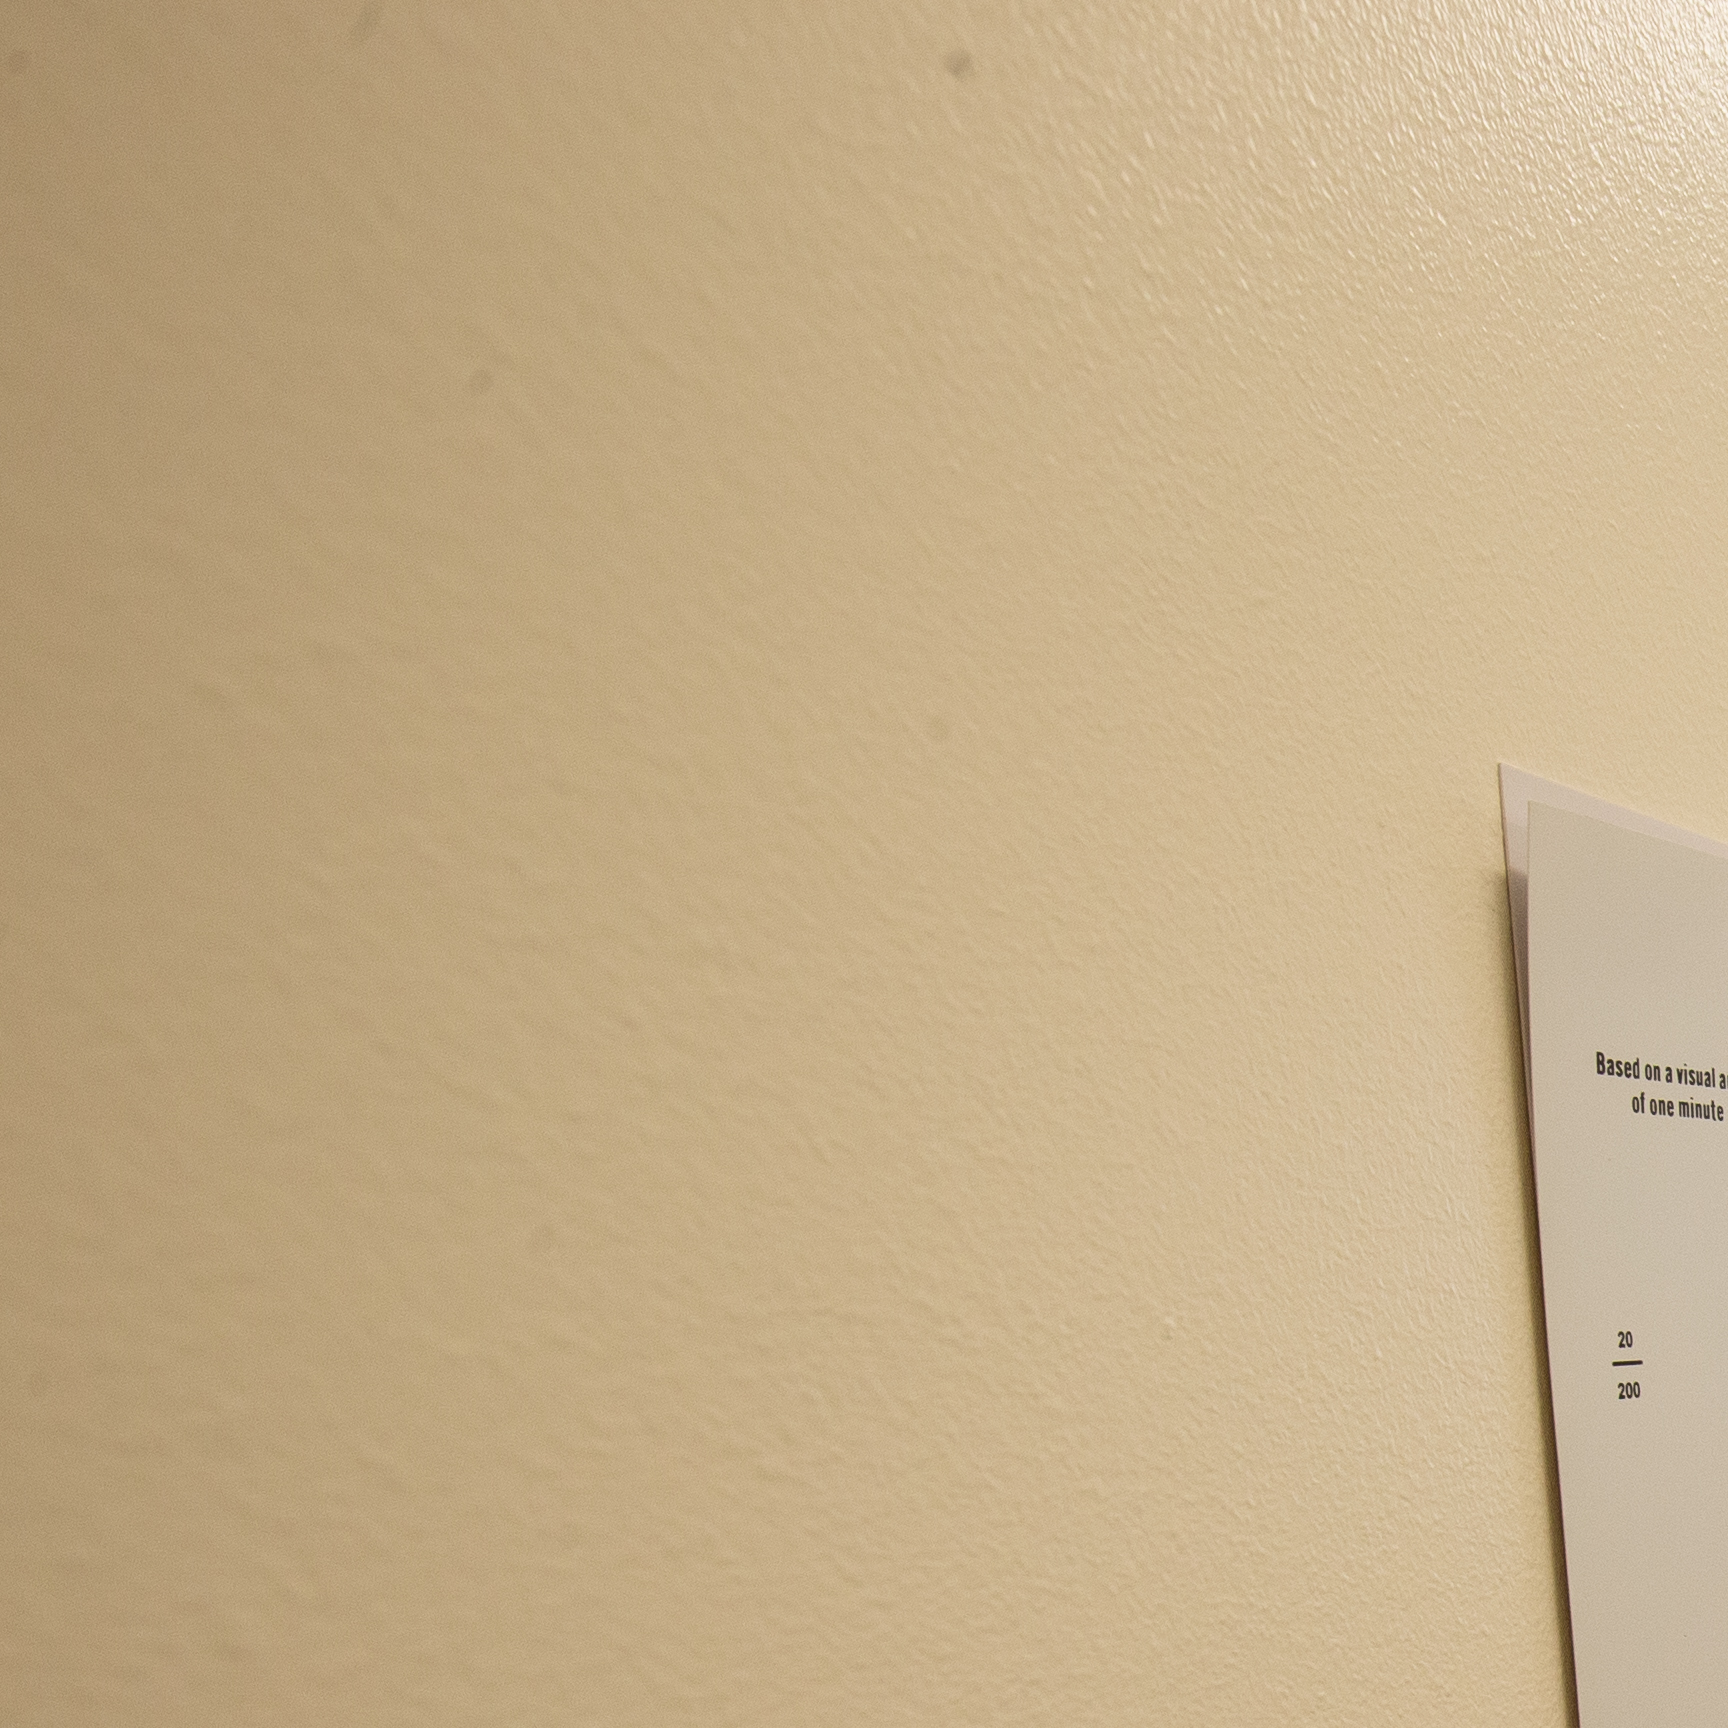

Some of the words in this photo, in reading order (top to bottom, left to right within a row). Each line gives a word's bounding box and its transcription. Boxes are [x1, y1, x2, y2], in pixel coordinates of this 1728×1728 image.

[1596, 1051, 1640, 1080] Based
[1644, 1064, 1662, 1082] on
[1665, 1066, 1674, 1083] a
[1676, 1063, 1716, 1089] visual
[1631, 1091, 1646, 1114] of
[1649, 1099, 1675, 1118] one
[1678, 1097, 1725, 1122] minute
[1618, 1331, 1634, 1349] 20
[1618, 1381, 1641, 1400] 200
